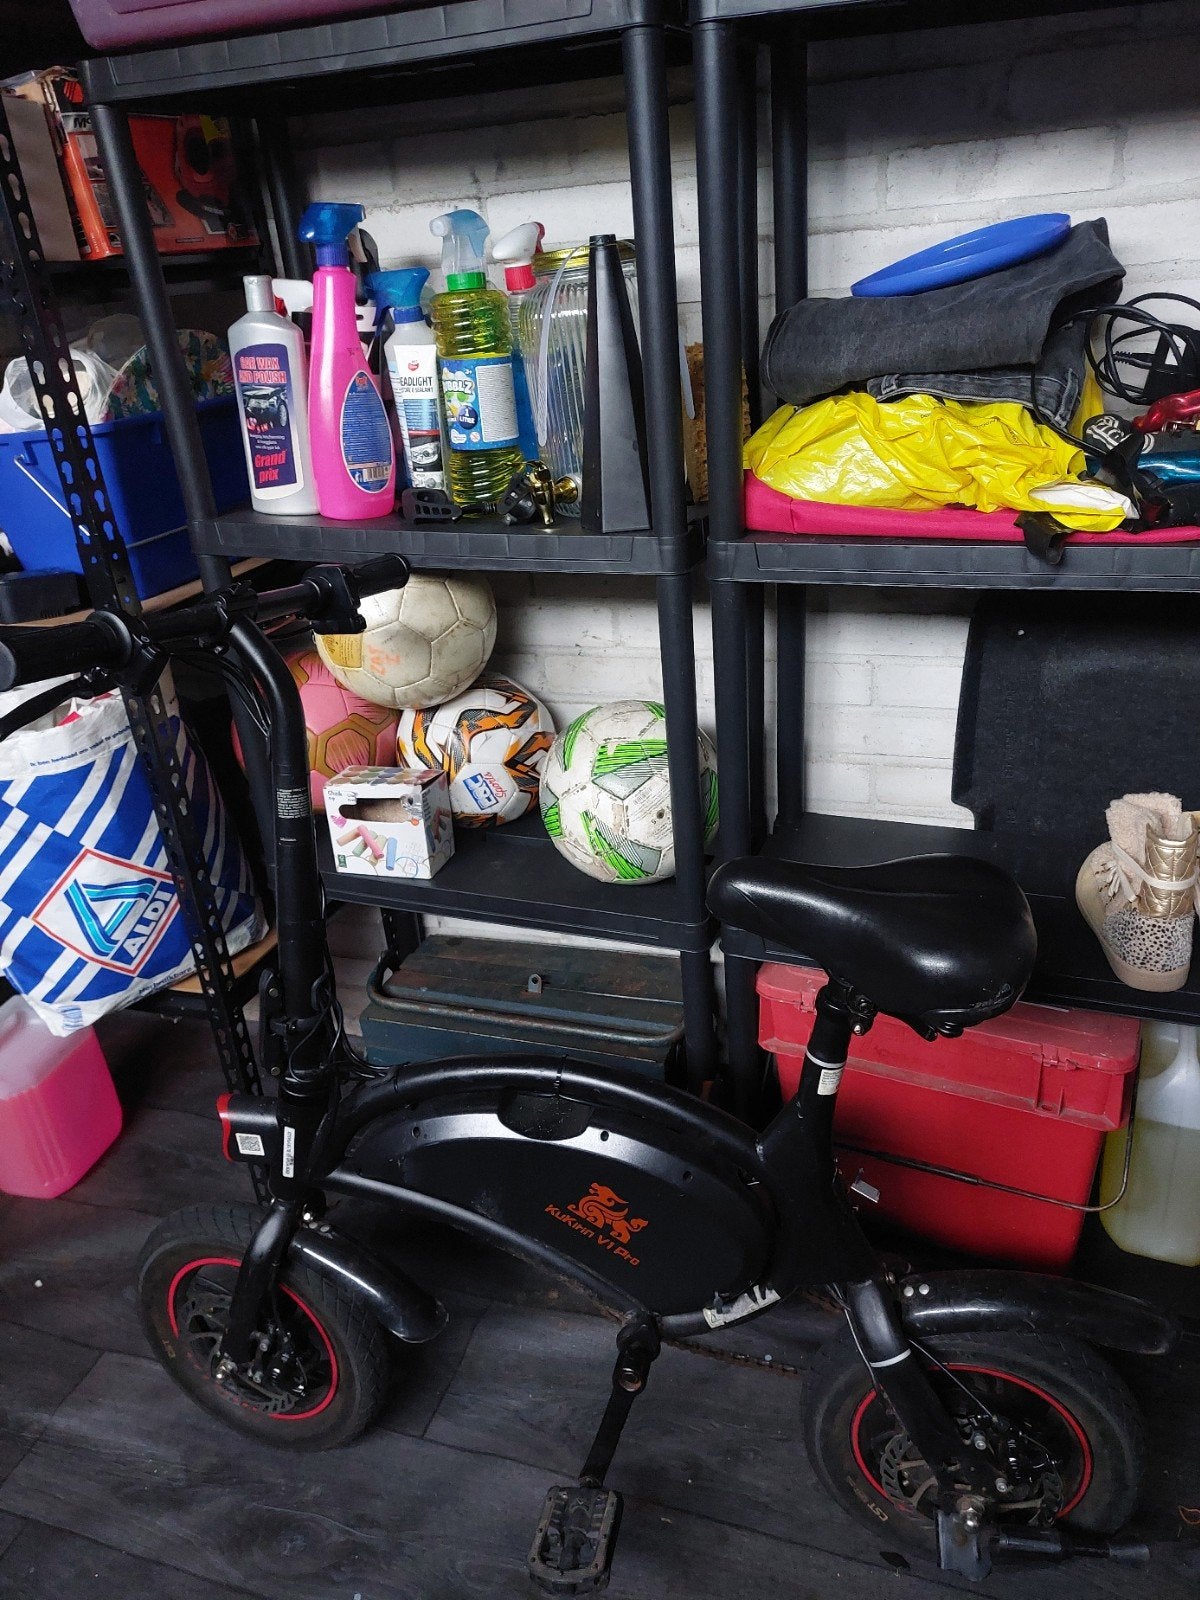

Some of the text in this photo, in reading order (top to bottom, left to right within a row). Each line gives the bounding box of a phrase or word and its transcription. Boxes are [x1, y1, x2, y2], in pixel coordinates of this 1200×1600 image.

[256, 356, 280, 370] WAX
[253, 370, 288, 384] POLISH
[400, 376, 433, 386] EADLIGHT
[464, 408, 470, 417] 1
[254, 449, 287, 468] Grand
[259, 467, 279, 484] prix
[122, 890, 173, 958] ALDI
[613, 1246, 641, 1266] Pro
